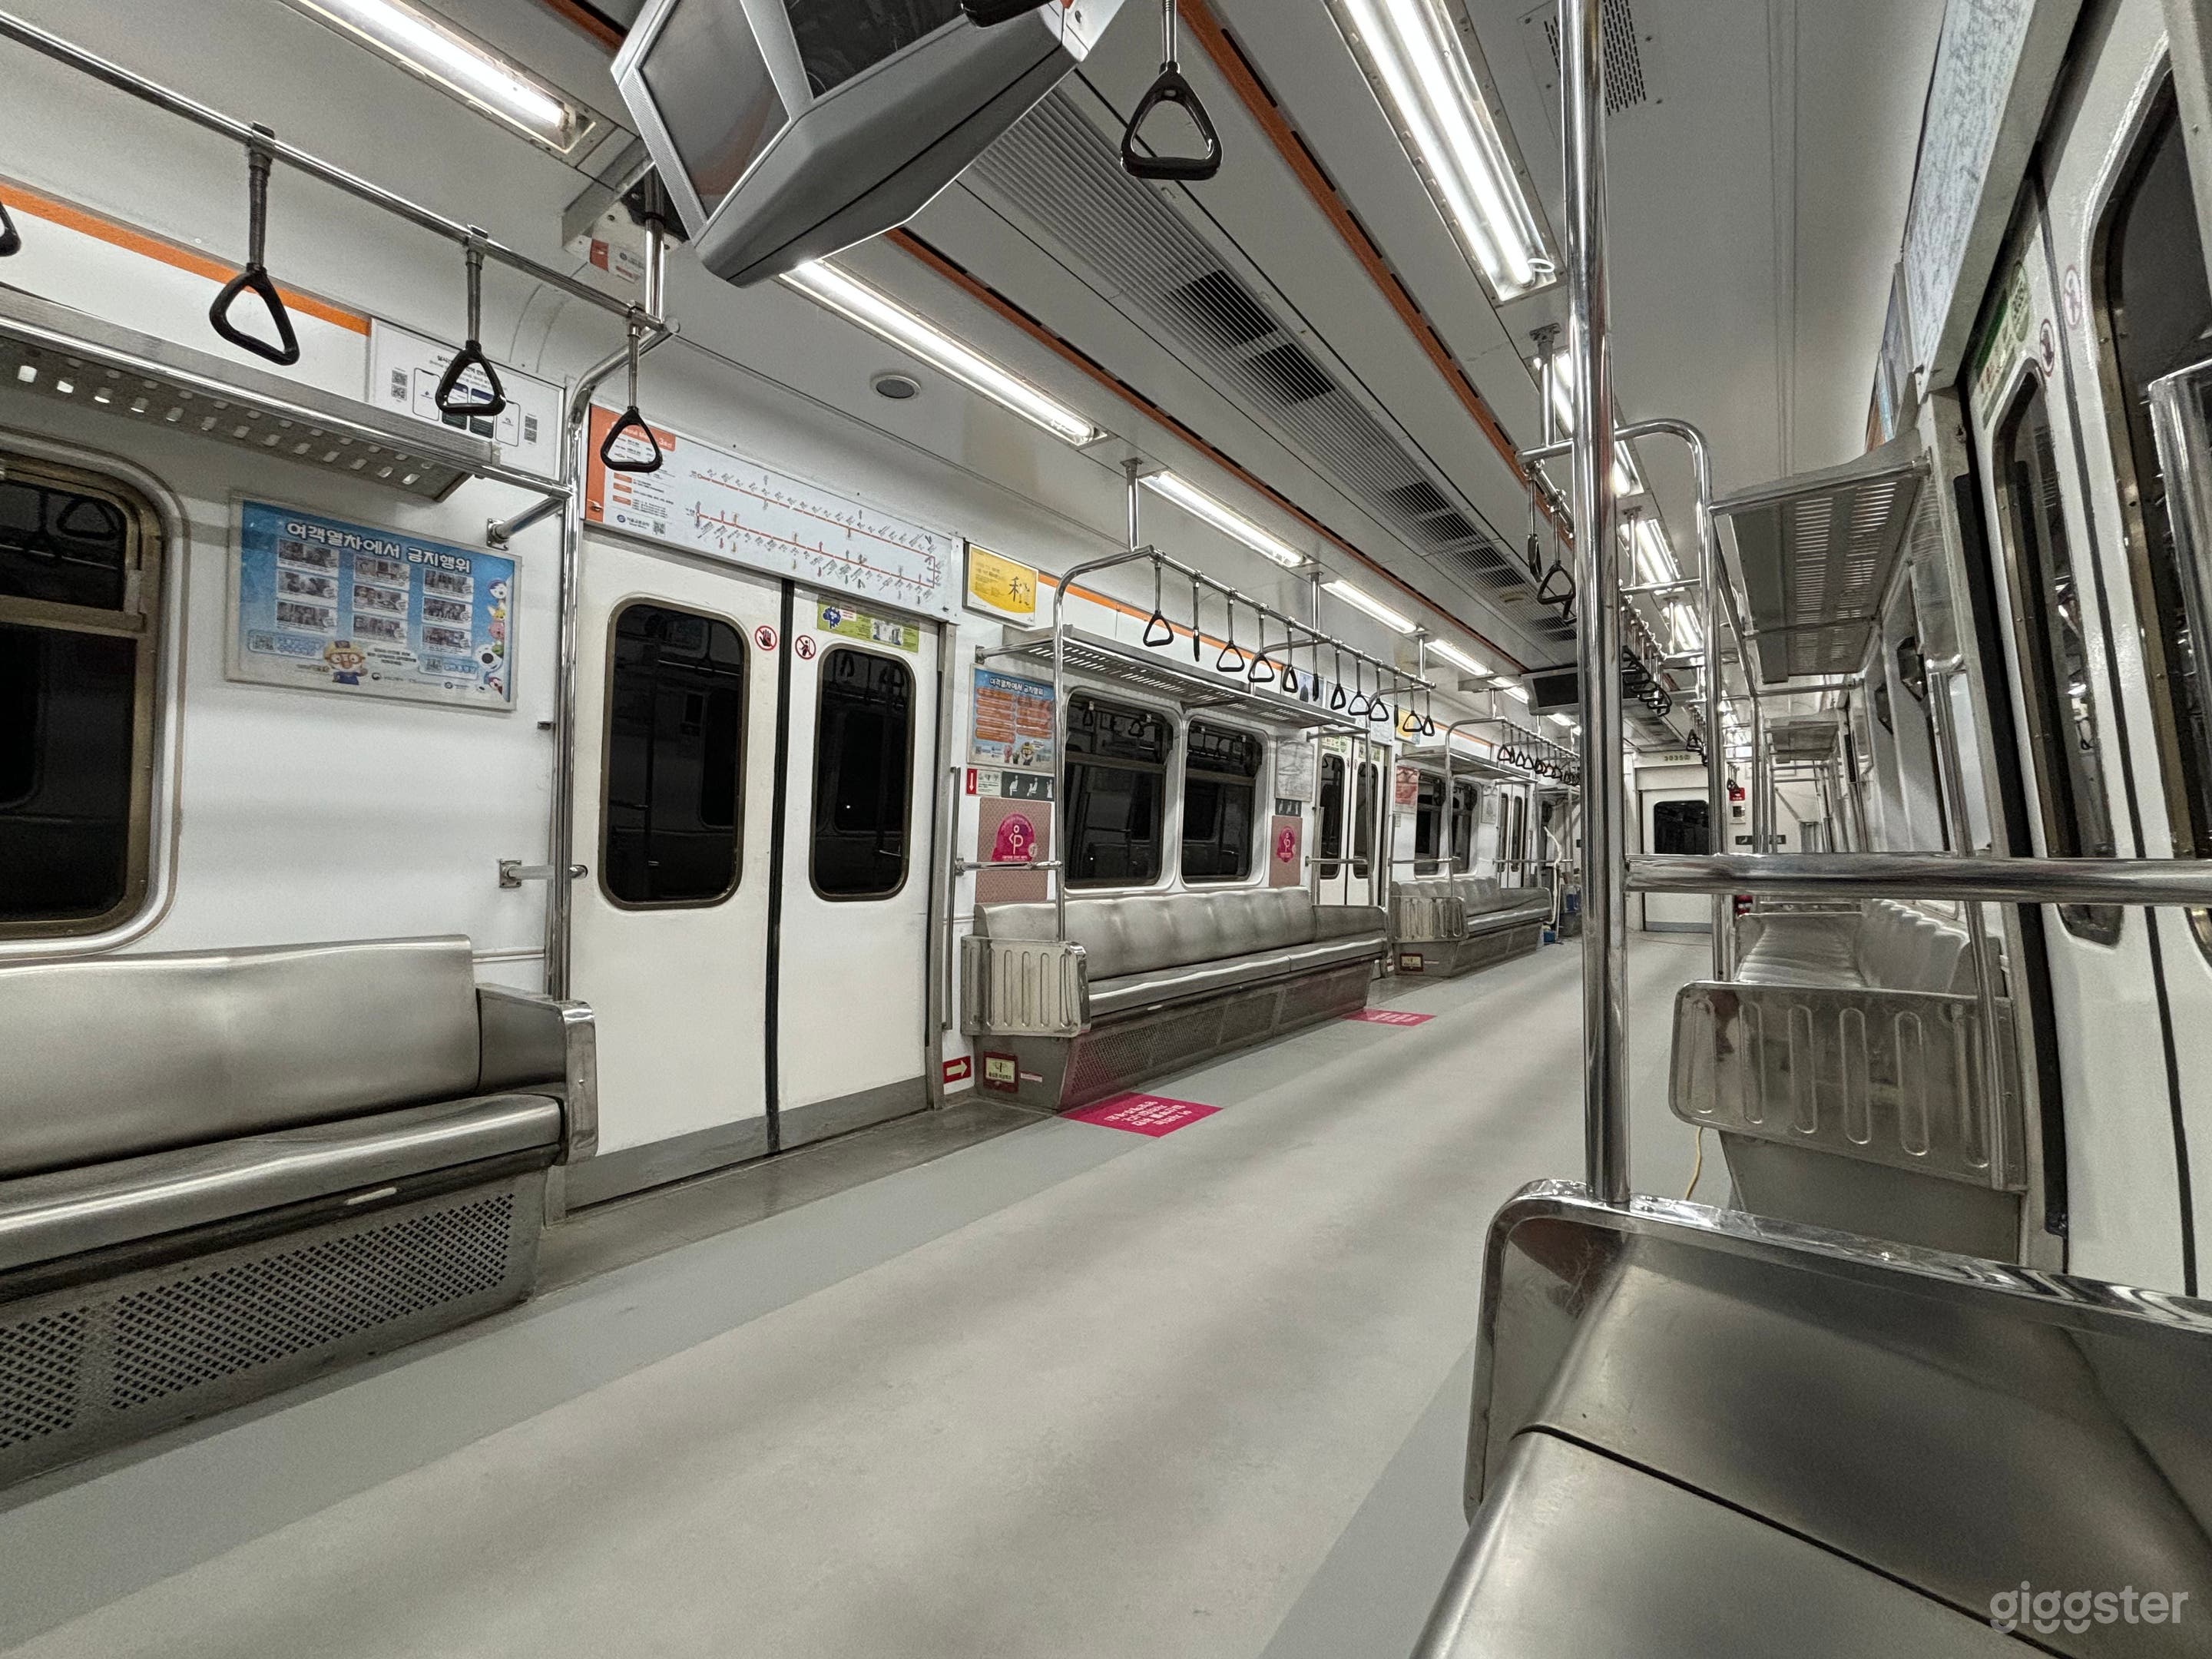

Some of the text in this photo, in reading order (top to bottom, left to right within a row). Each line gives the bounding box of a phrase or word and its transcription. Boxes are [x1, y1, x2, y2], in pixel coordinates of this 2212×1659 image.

[286, 522, 472, 574] 여객열차에서 금지행위
[1150, 1104, 1186, 1118] 임산부를
[1153, 1114, 1184, 1125] 자리는
